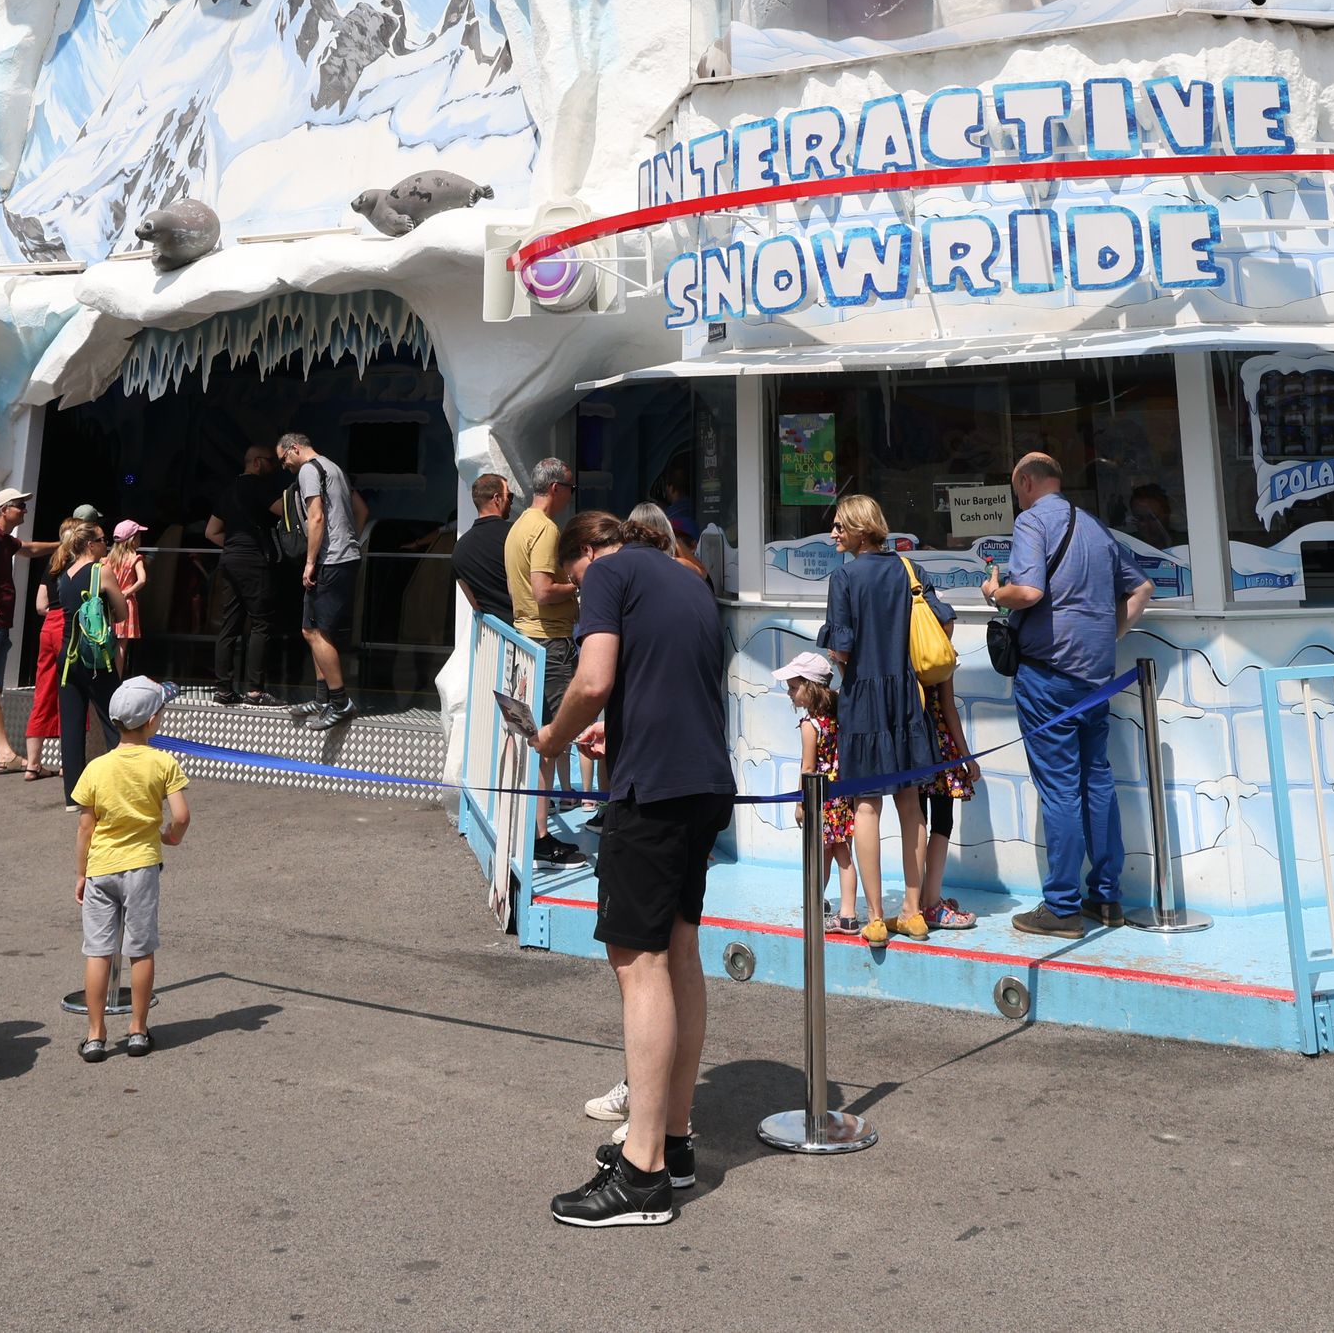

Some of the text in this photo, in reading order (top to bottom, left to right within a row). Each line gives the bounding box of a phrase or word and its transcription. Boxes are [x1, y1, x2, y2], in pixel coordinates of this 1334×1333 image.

[637, 74, 1297, 216] INTERACTIVE
[664, 204, 1227, 330] SNOWRIDE
[954, 494, 1006, 507] Nur Bargeld
[960, 511, 1003, 522] Cash only
[983, 542, 1009, 550] CAUTION
[1255, 577, 1274, 586] Foto
[1284, 576, 1289, 586] 5
